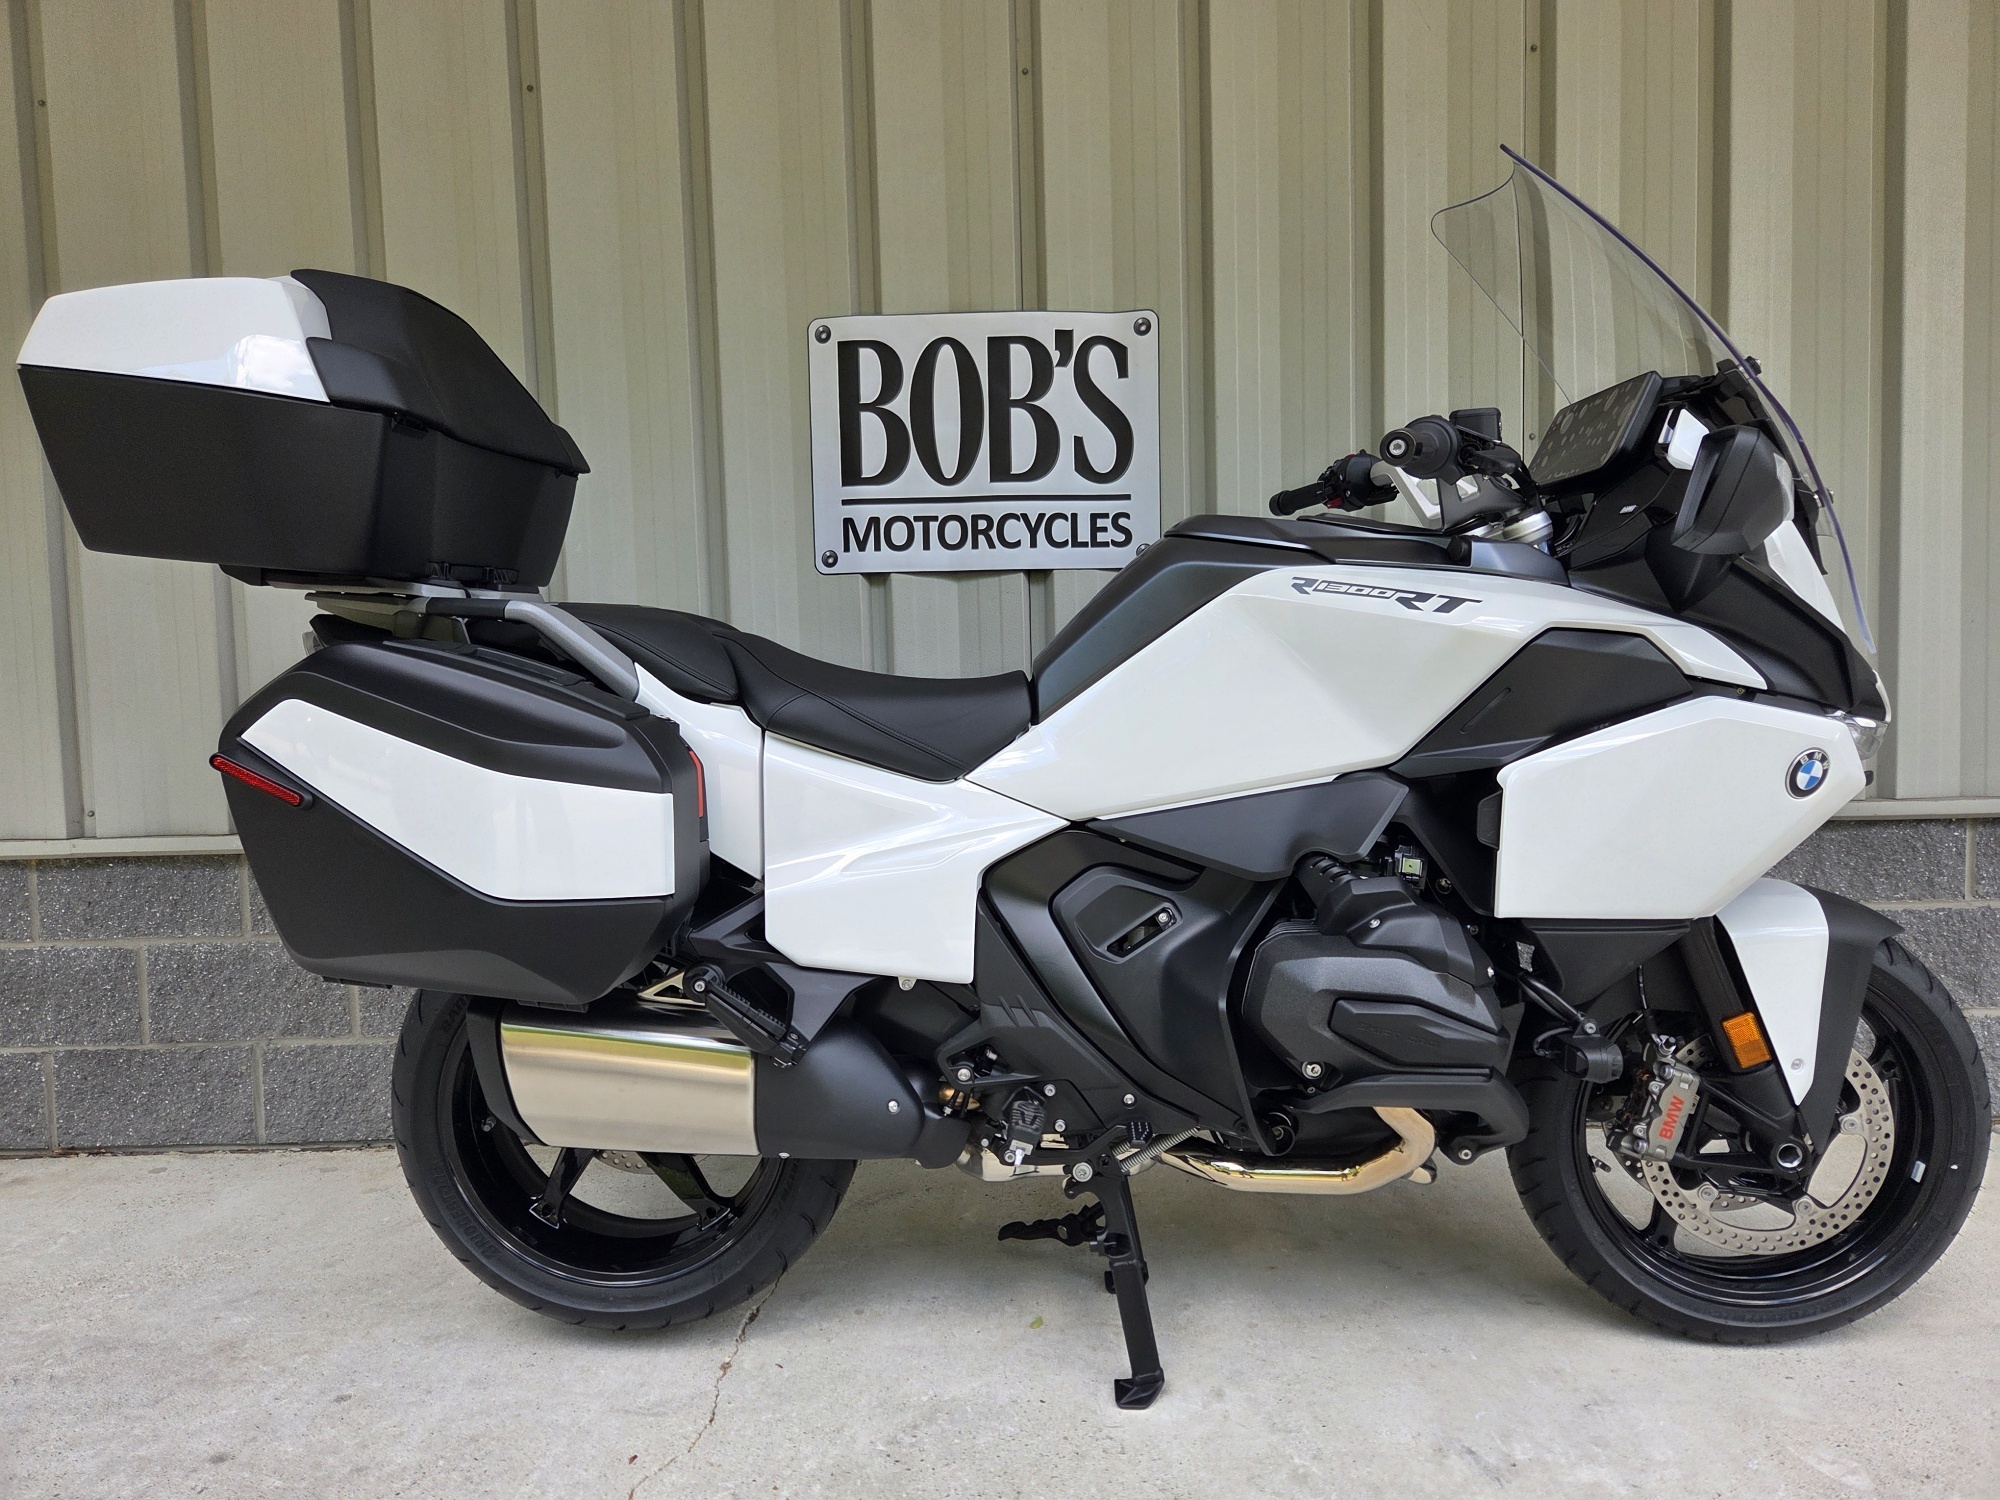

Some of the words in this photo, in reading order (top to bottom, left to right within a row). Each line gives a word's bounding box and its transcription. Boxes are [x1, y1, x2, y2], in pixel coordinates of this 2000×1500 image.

[837, 329, 1134, 487] BOB'S
[842, 512, 1133, 553] MOTORCYCLES
[1659, 1094, 1685, 1140] BMW
